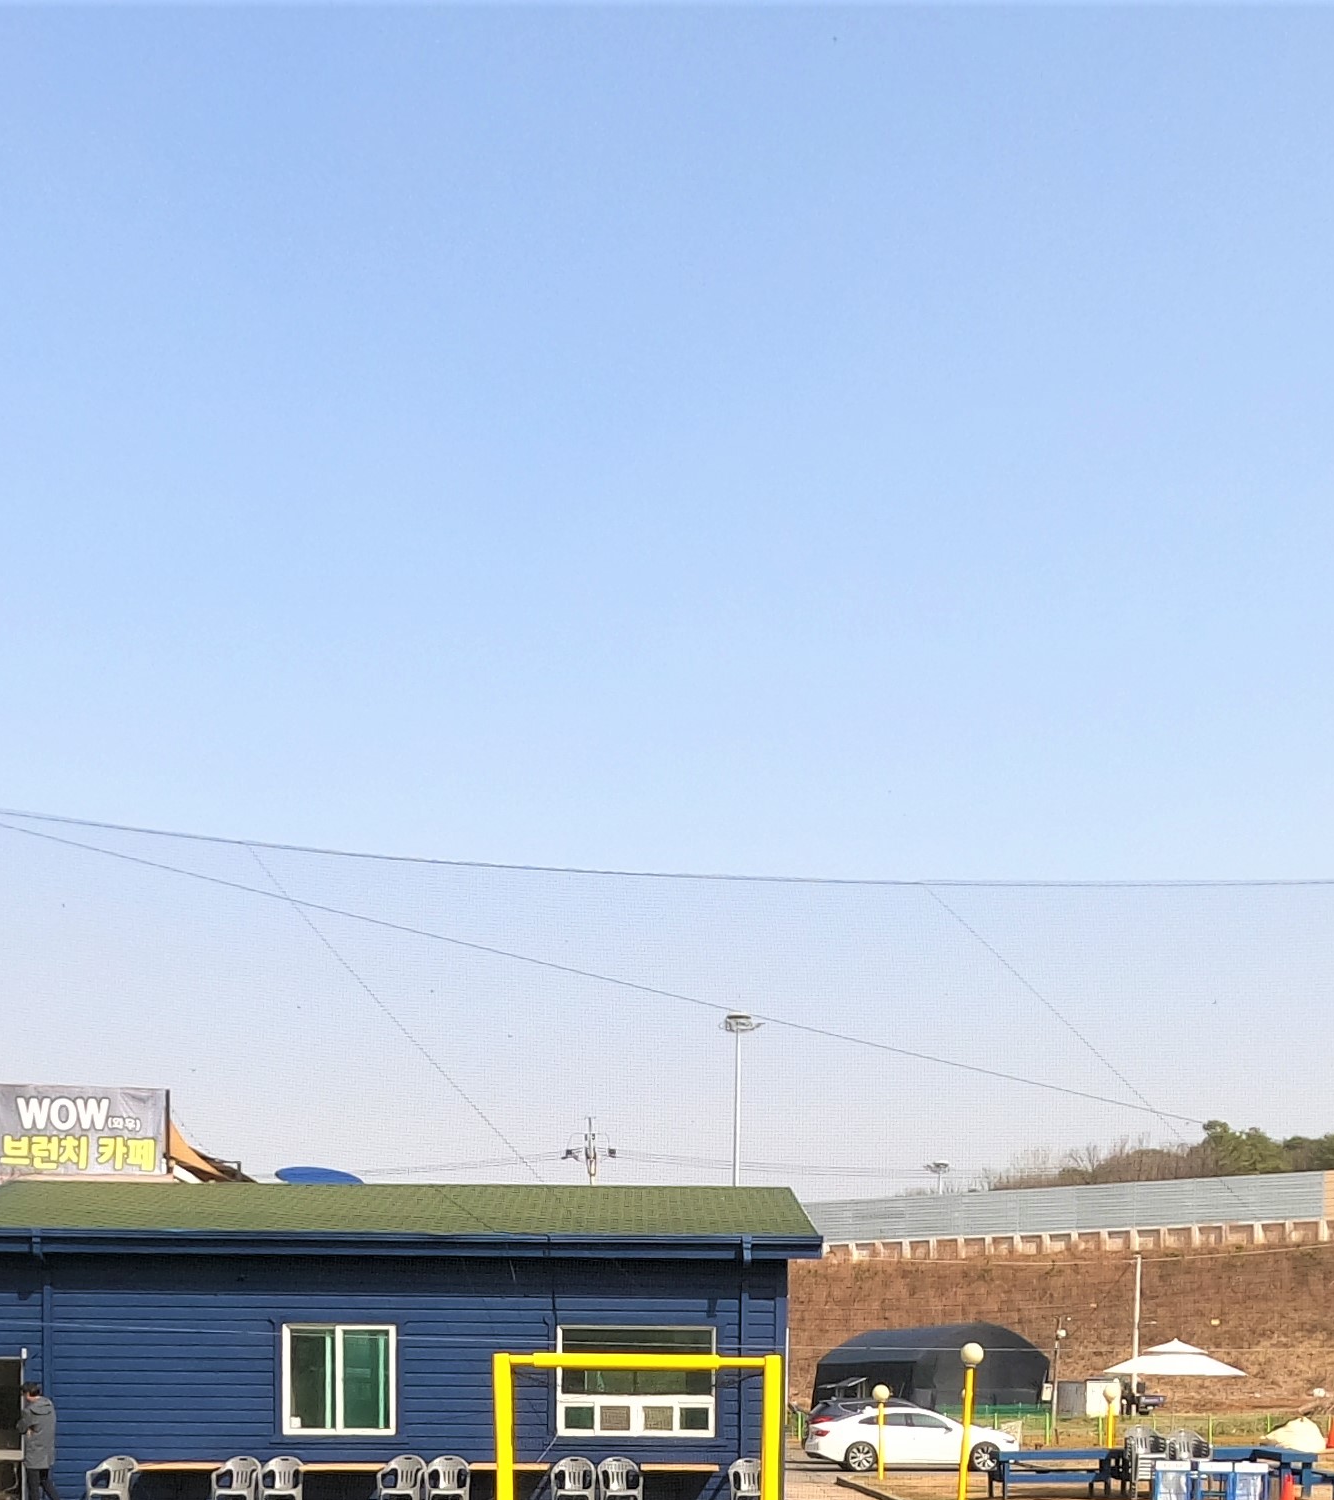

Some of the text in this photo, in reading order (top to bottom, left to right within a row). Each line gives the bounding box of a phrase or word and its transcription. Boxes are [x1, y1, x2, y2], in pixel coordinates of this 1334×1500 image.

[17, 1097, 109, 1131] WOW
[0, 1134, 156, 1172] 브런치 카페
